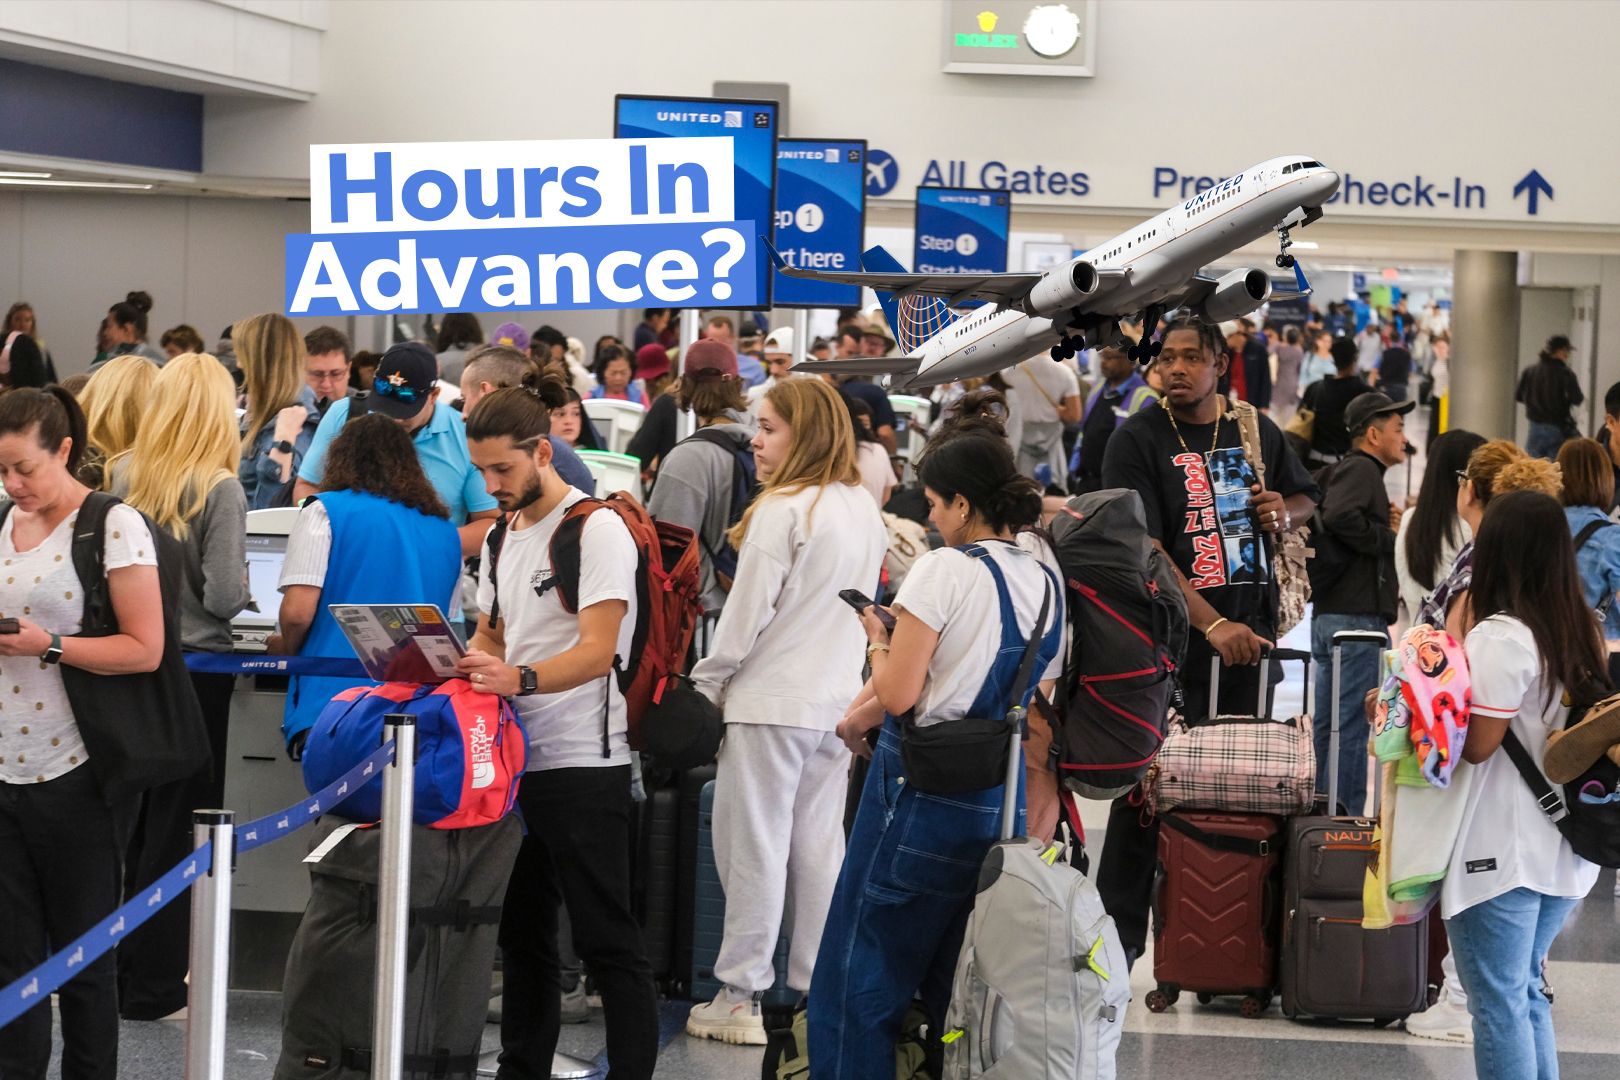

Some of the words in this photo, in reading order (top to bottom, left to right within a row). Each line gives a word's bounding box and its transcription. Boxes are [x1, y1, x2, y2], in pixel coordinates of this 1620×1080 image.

[656, 111, 722, 124] UNITED
[921, 159, 965, 188] All
[980, 160, 1090, 196] Gates
[1326, 173, 1486, 209] heck-In
[1185, 173, 1244, 211] UNITED
[920, 235, 954, 252] Step
[799, 247, 845, 269] here
[1172, 452, 1213, 508] HOOD
[1184, 511, 1202, 533] N
[1201, 506, 1216, 530] THE
[1189, 532, 1226, 590] BOYZ
[241, 661, 277, 669] UNITED
[468, 727, 481, 763] FACE
[475, 714, 487, 762] NORTH
[485, 734, 495, 761] THE
[1325, 832, 1374, 842] NAUT
